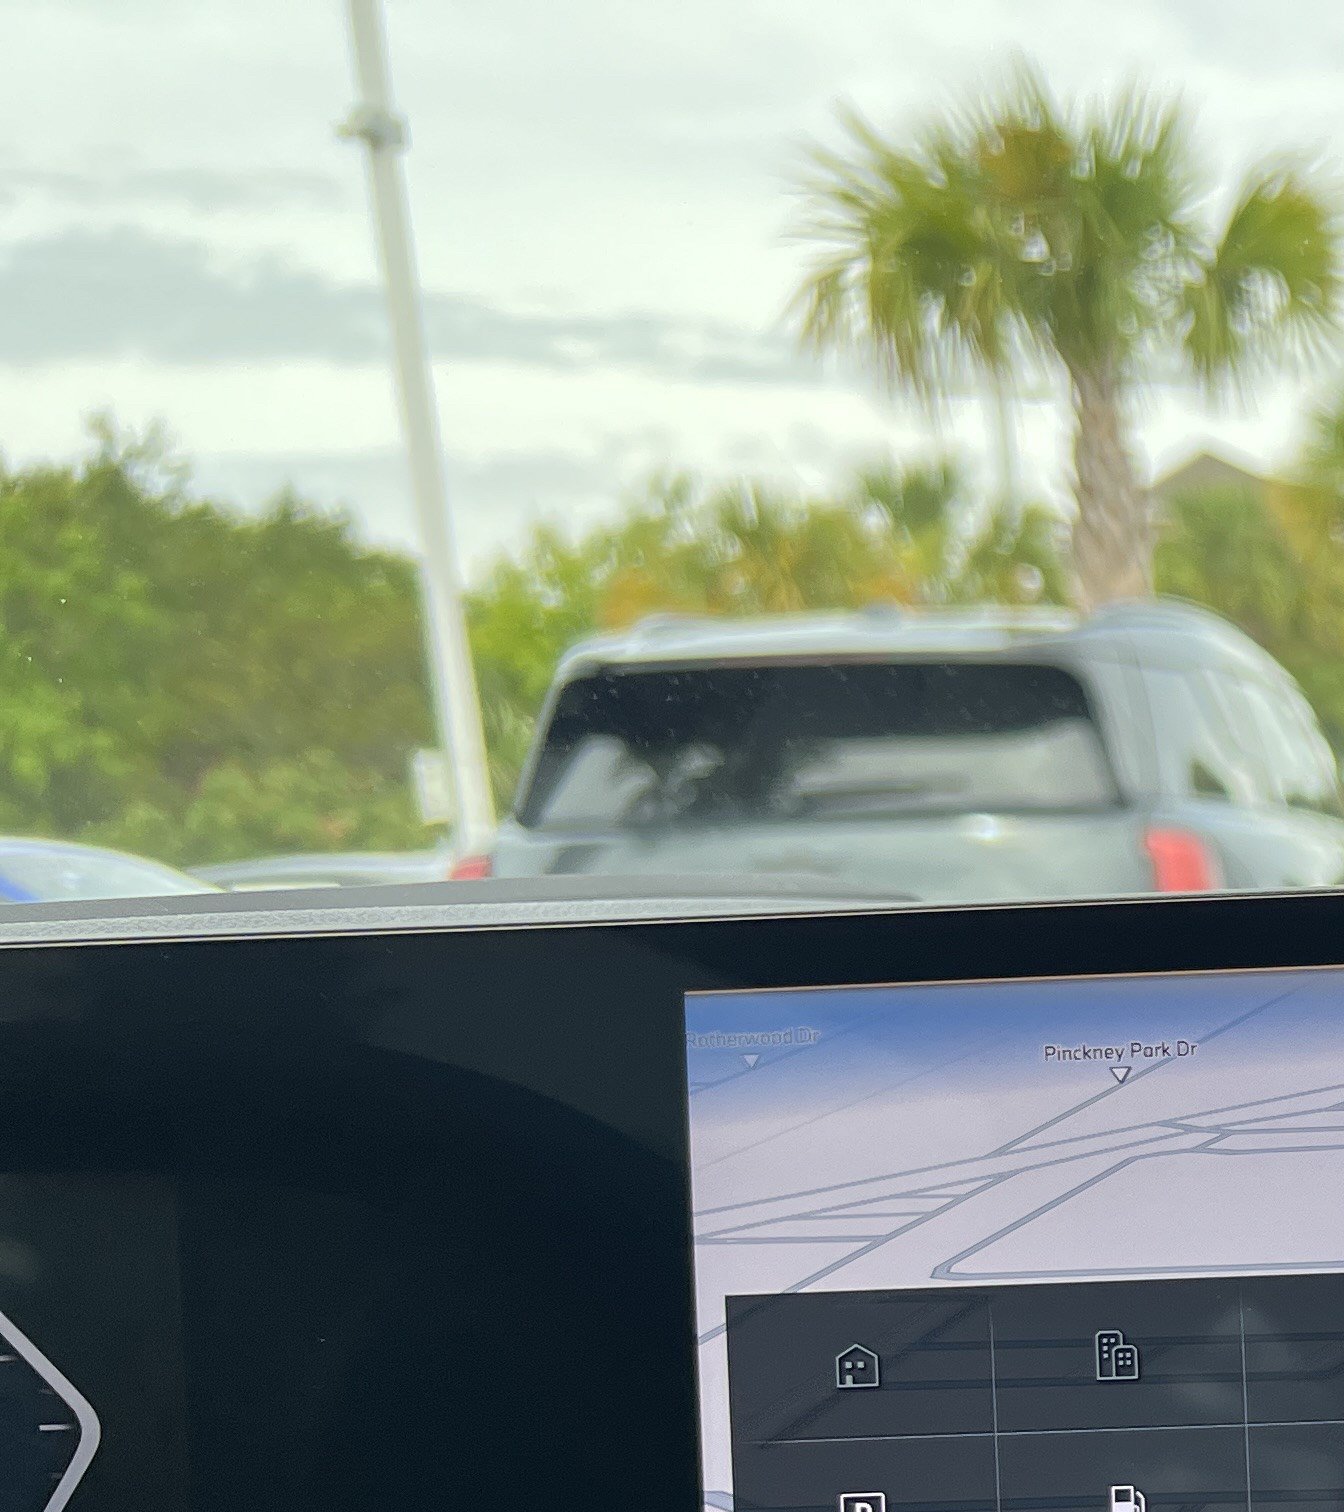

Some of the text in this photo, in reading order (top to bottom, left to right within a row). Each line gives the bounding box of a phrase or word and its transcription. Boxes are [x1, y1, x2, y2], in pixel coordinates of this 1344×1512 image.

[795, 1026, 821, 1043] Dr
[1044, 1040, 1198, 1062] Pinckney Park Dr
